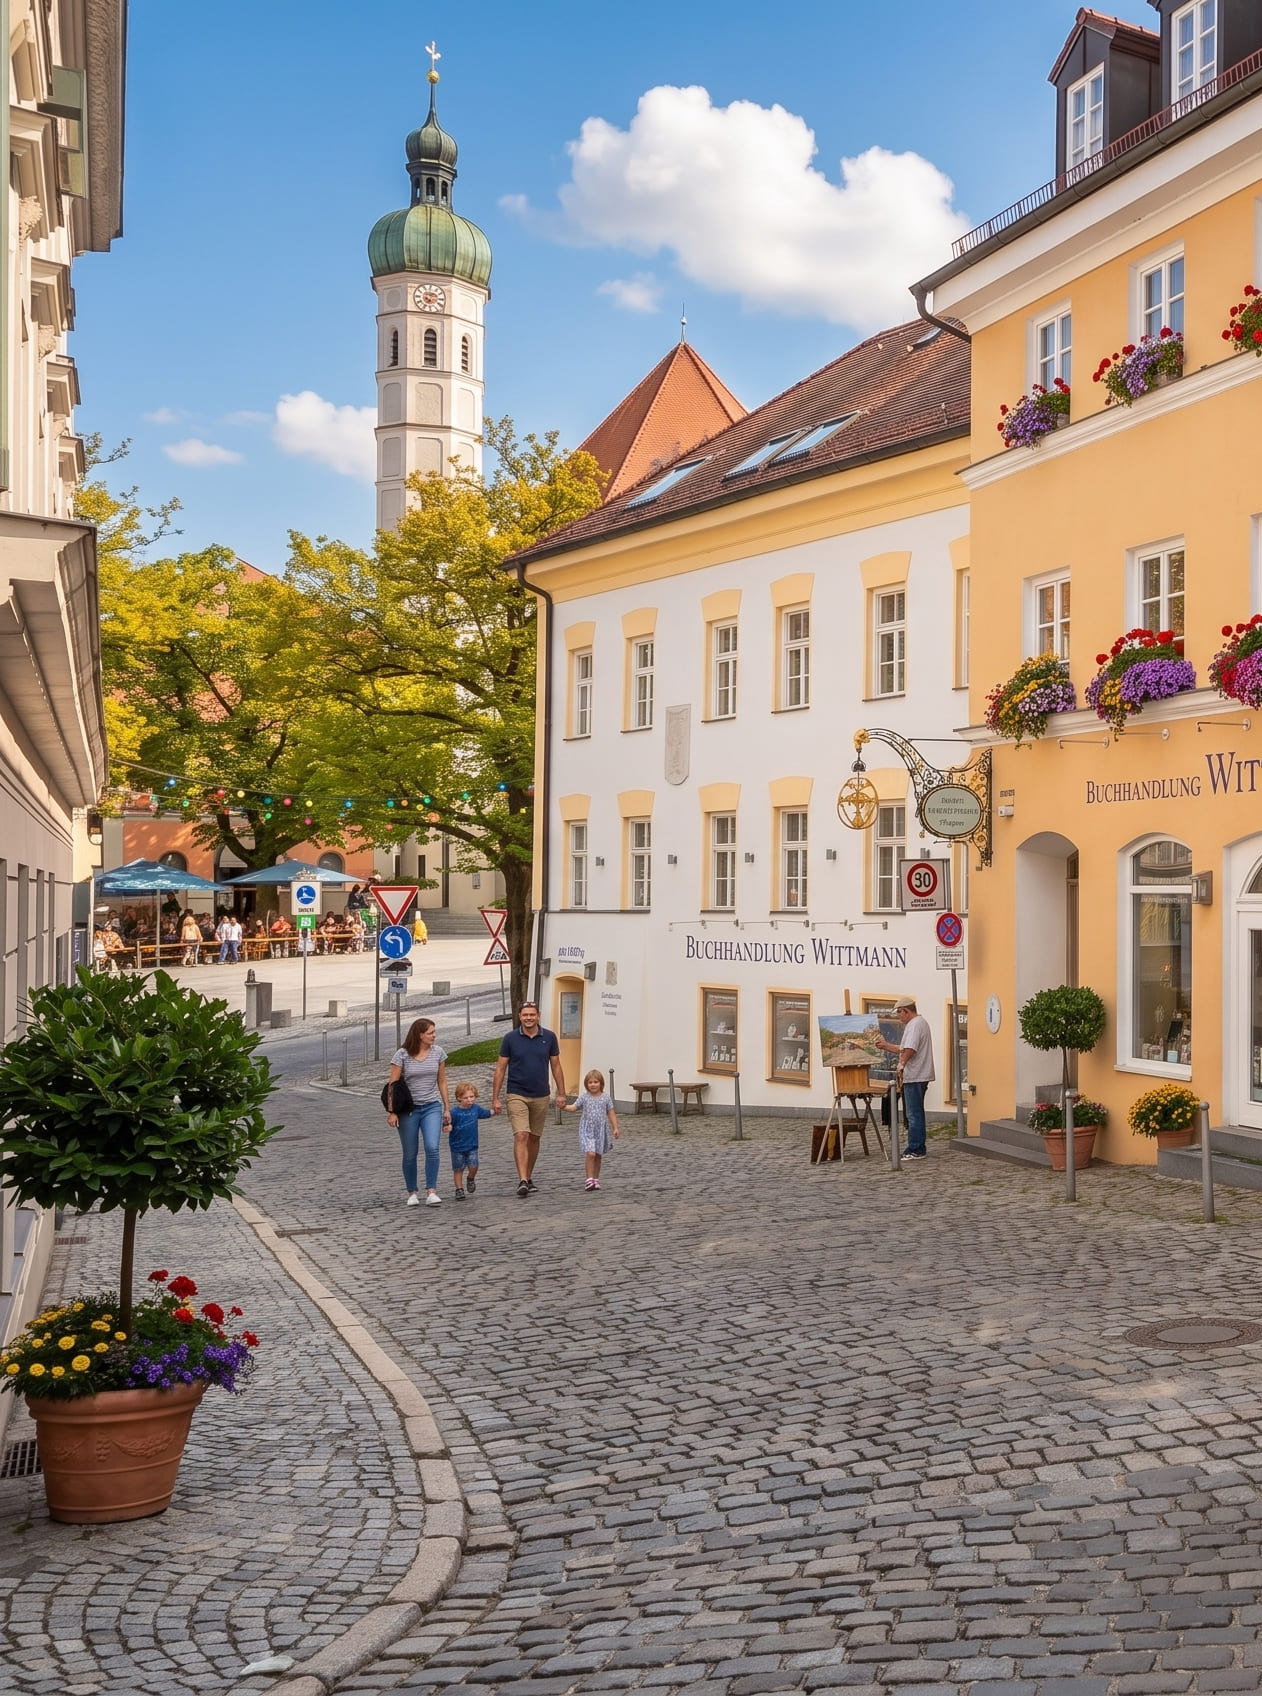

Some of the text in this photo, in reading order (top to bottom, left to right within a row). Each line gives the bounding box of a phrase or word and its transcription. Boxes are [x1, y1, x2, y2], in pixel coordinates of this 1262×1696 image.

[1086, 776, 1201, 804] BUCHHANDLUNG
[914, 871, 931, 889] 30
[686, 935, 805, 964] BUCHHANDLUNG
[811, 937, 907, 968] WITTMANN
